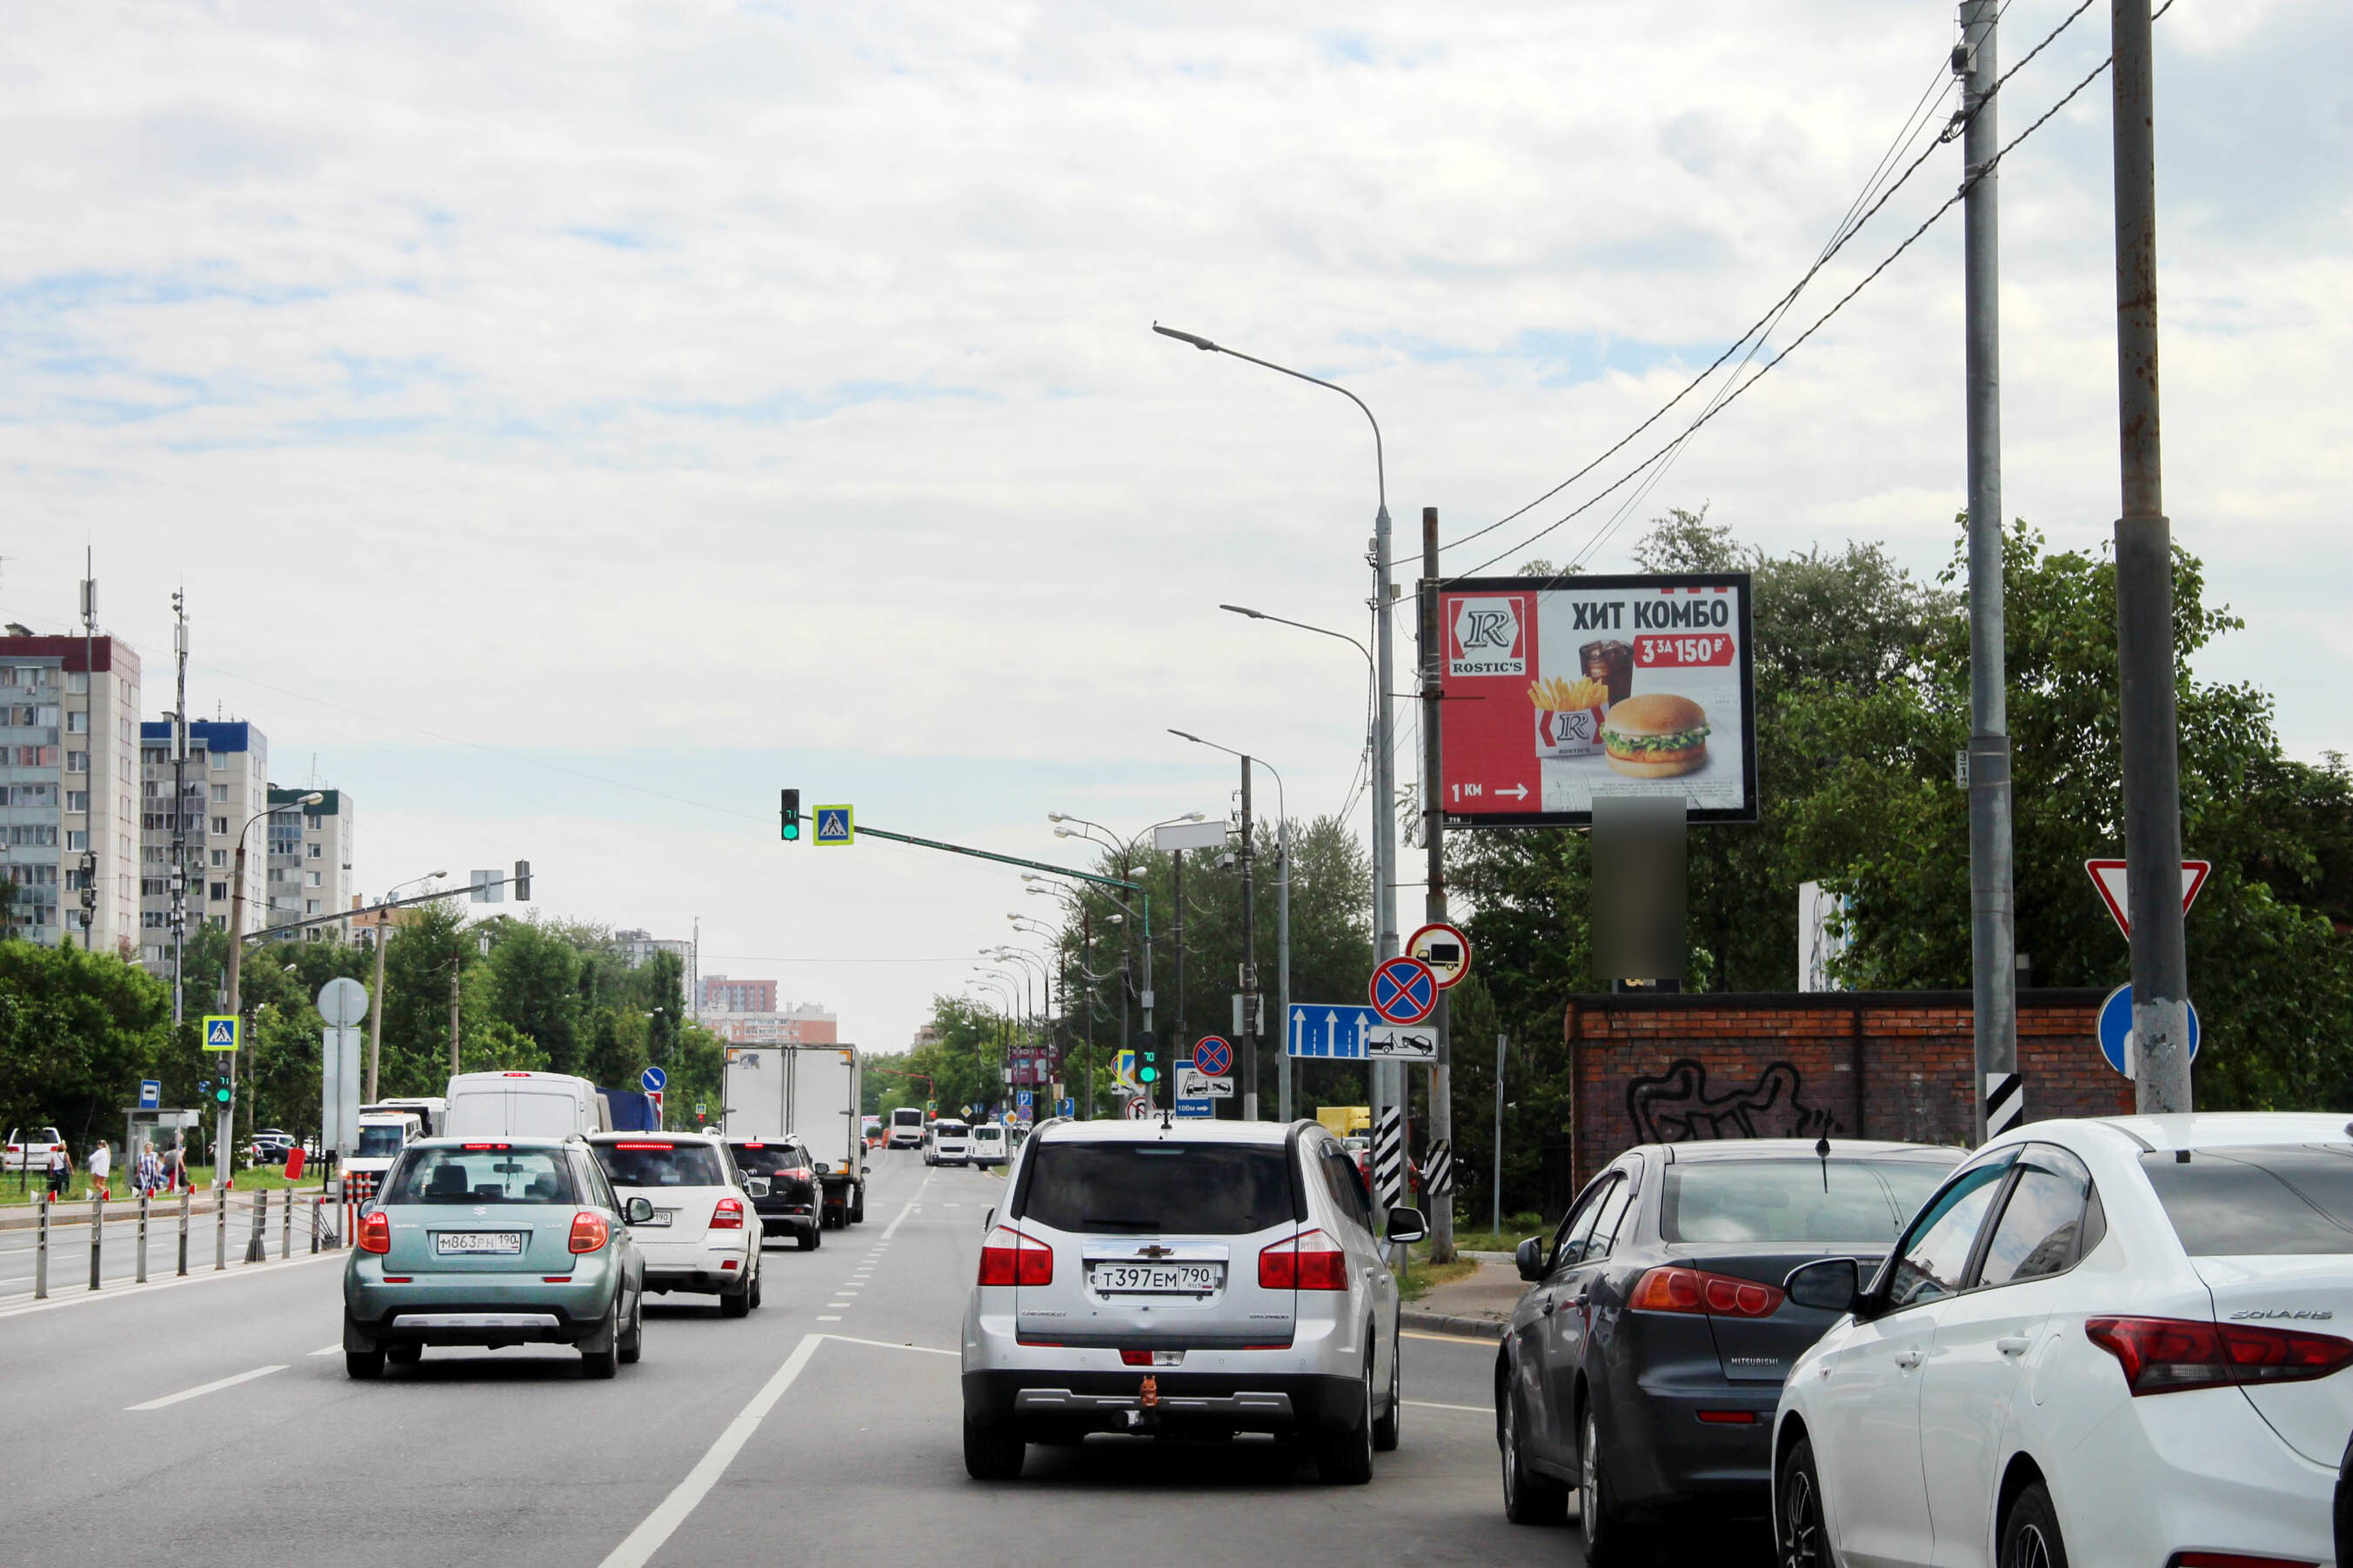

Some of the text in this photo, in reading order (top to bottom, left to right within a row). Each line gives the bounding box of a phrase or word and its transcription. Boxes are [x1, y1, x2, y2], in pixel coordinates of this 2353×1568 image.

[1572, 599, 1728, 631] ХИТ КОМБО
[1641, 640, 1654, 663] 3
[1453, 662, 1522, 673] ROSTIC'S
[1452, 784, 1482, 803] 1 КМ
[786, 810, 798, 819] 71
[1144, 1051, 1155, 1061] 70
[219, 1077, 229, 1085] 71
[2229, 1309, 2334, 1320] SOLARIS
